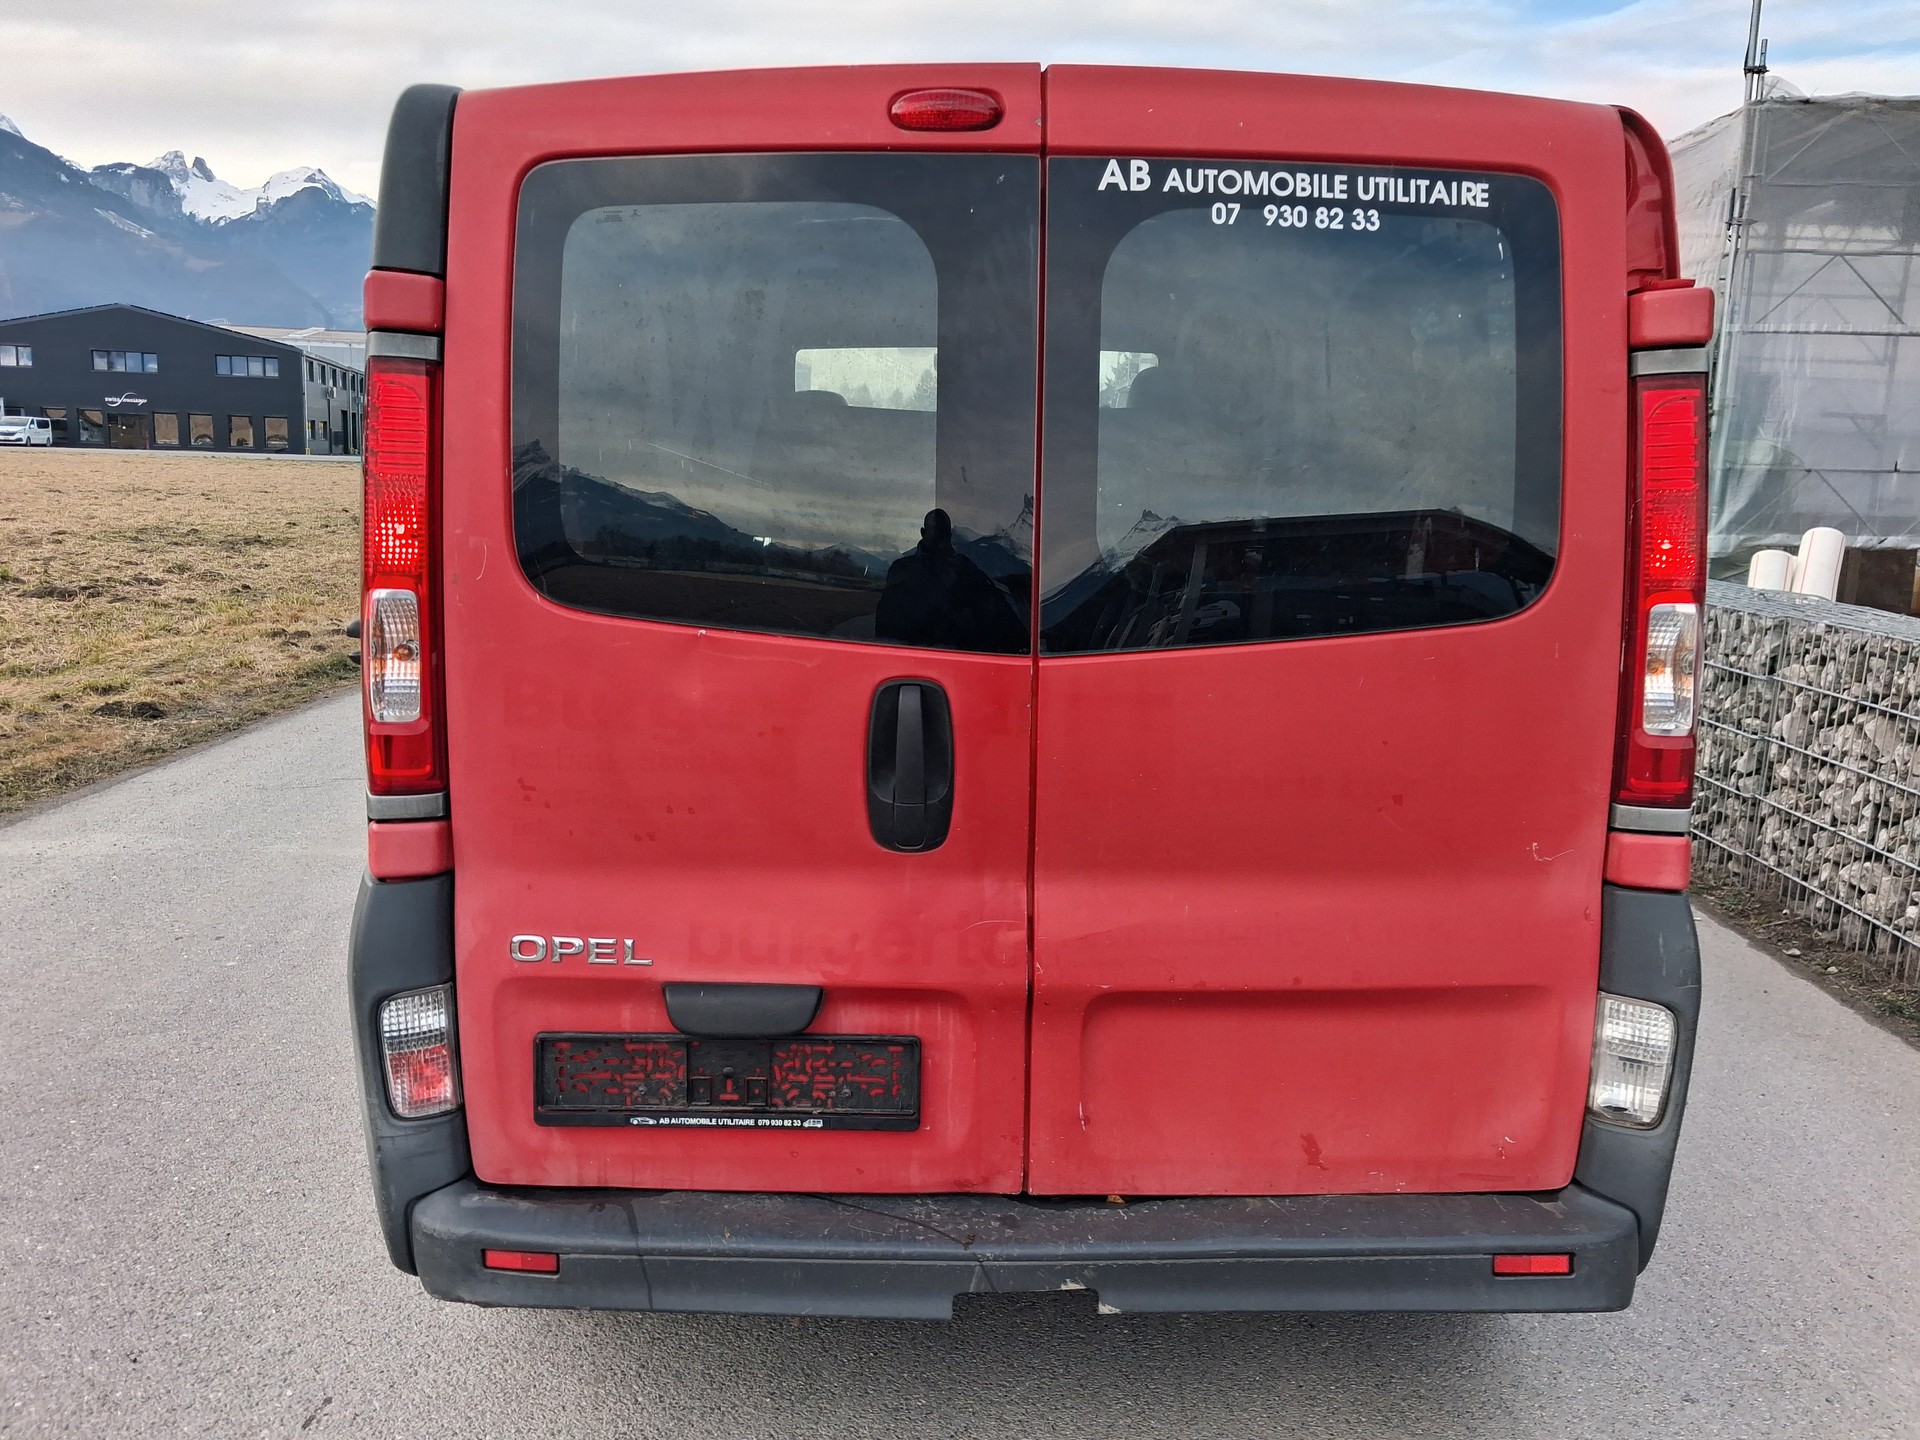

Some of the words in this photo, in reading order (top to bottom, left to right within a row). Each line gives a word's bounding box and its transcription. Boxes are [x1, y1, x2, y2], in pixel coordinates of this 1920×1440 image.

[1098, 159, 1151, 191] AB
[1163, 168, 1347, 199] AUTOMOBILE
[1357, 176, 1489, 207] UTILITAIRE
[1212, 203, 1240, 224] 07
[1264, 205, 1307, 227] 930
[1315, 207, 1343, 229] 82
[1351, 209, 1380, 231] 33
[510, 934, 653, 965] OPEL
[659, 1117, 670, 1125] AB
[670, 1117, 717, 1126] AUTOMOBILE
[718, 1118, 755, 1126] UTILITAIRE
[770, 1119, 783, 1127] 930
[783, 1119, 792, 1127] 82
[792, 1119, 802, 1127] 33
